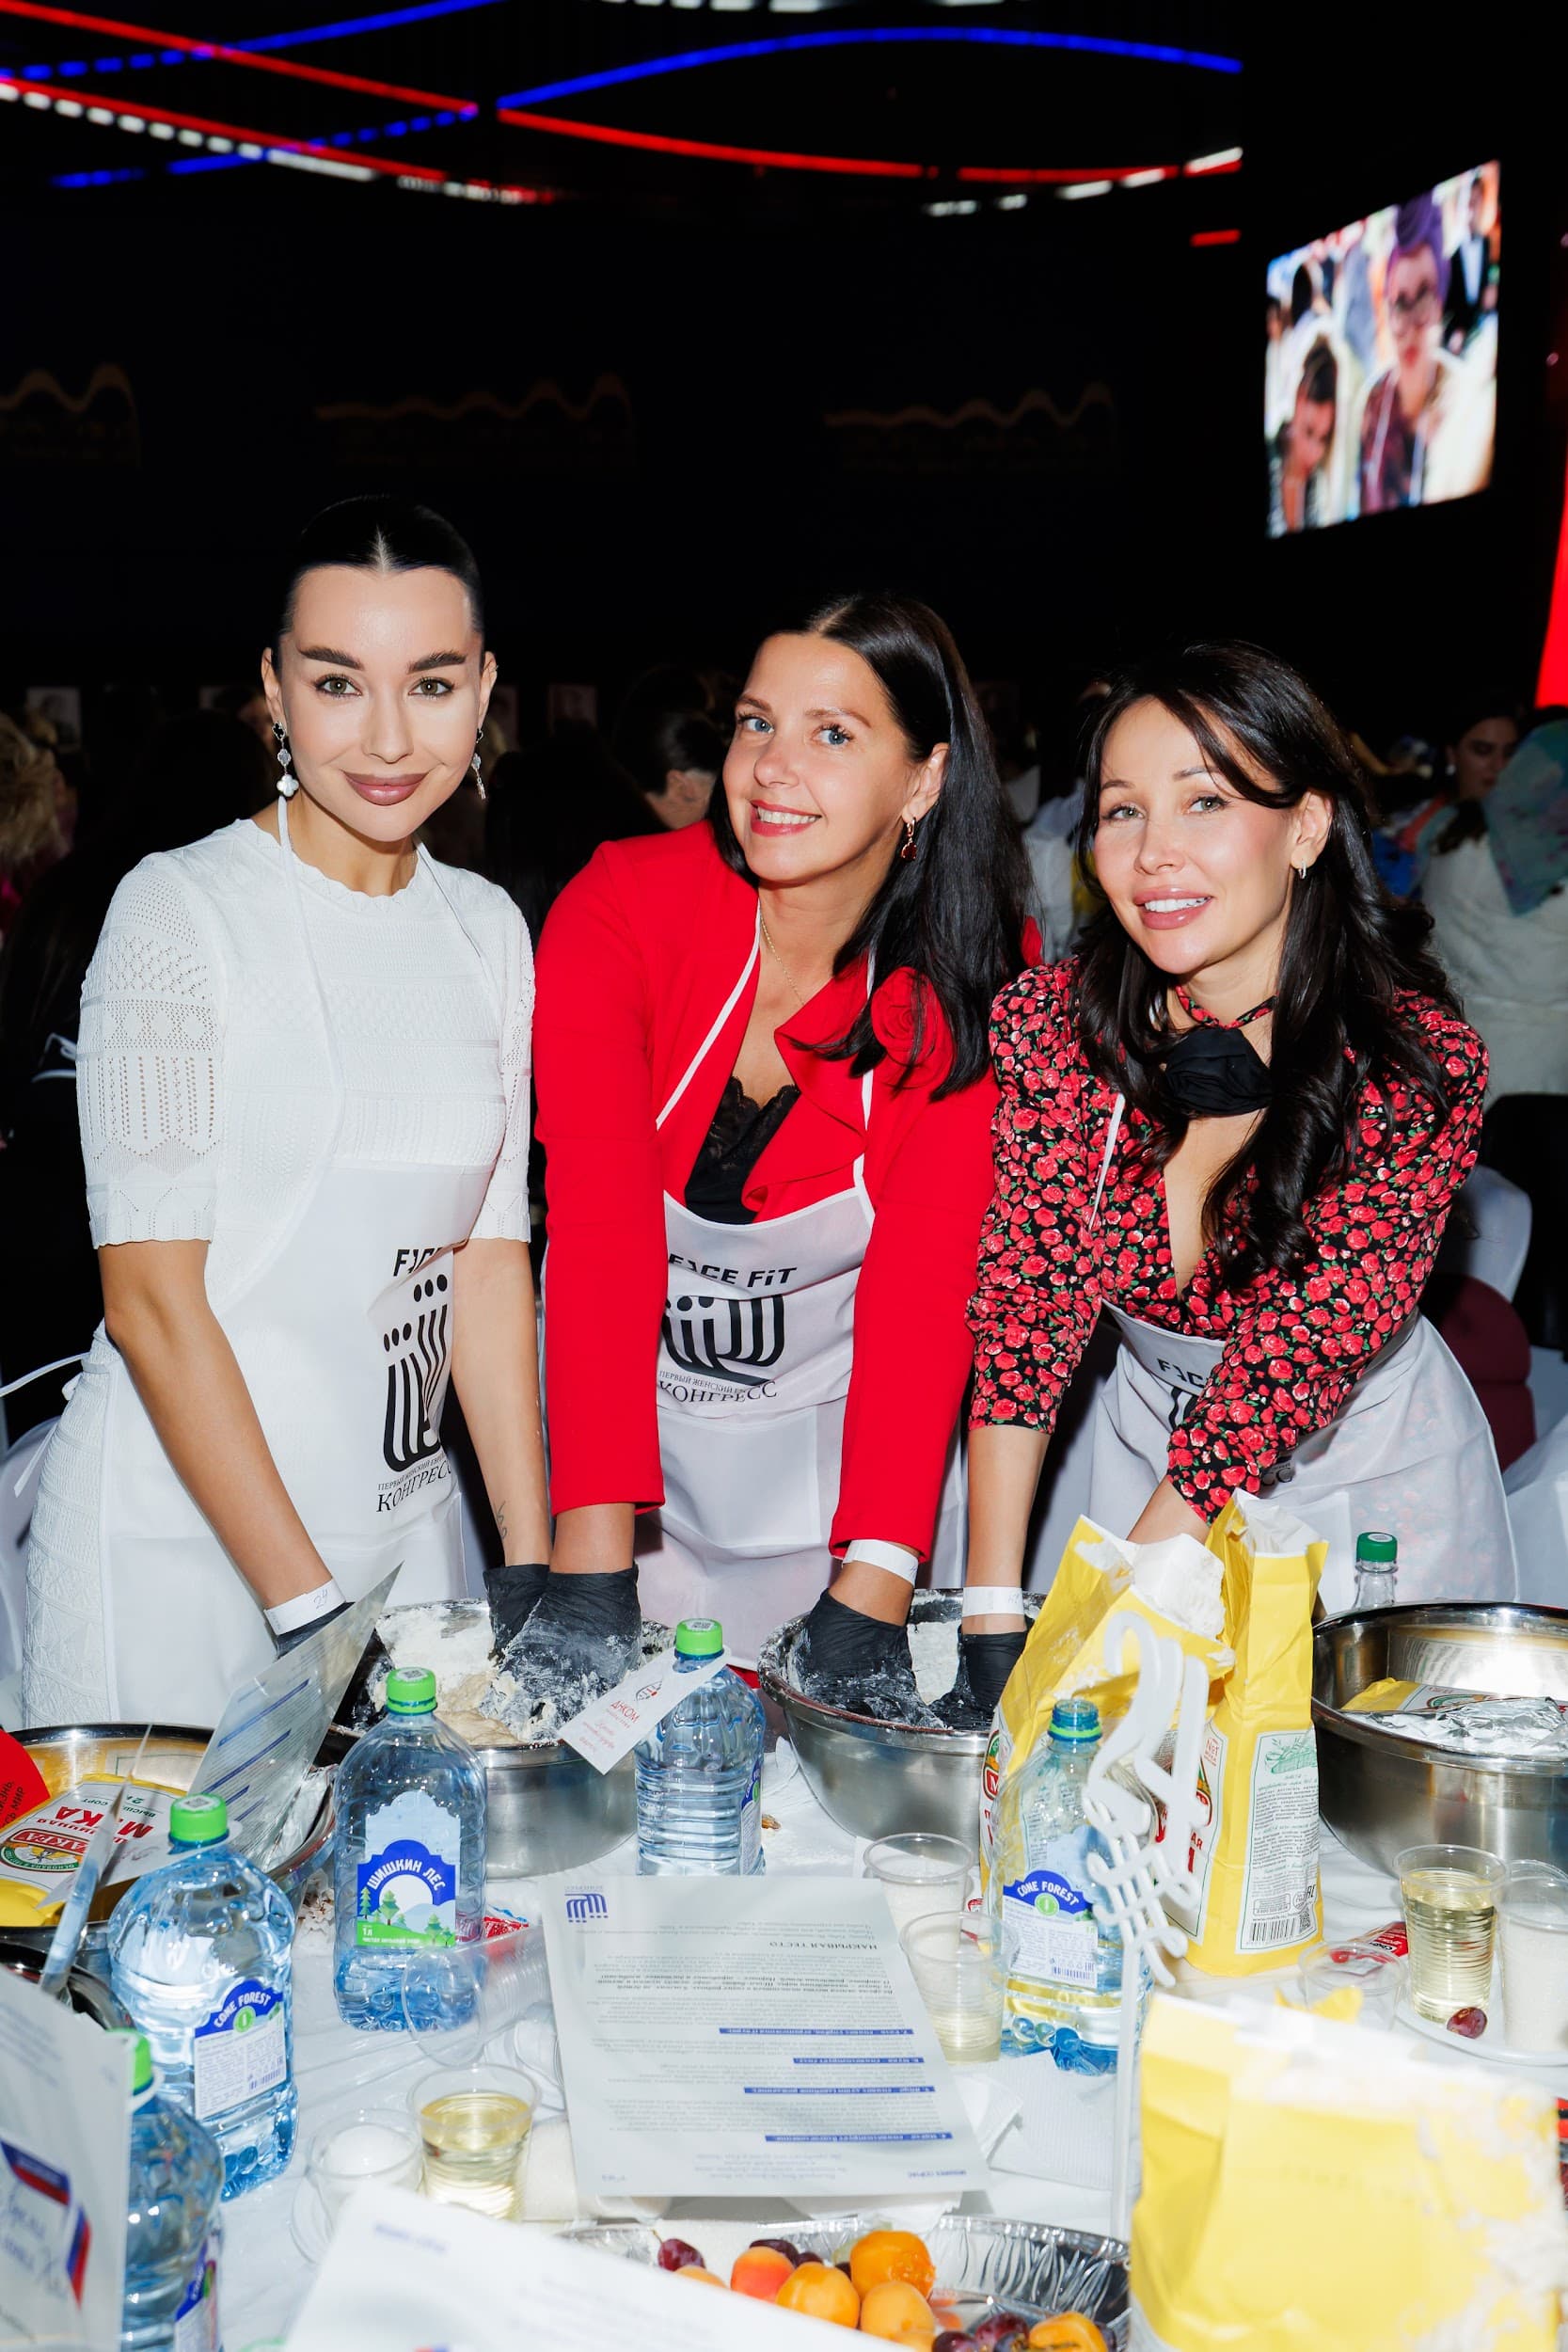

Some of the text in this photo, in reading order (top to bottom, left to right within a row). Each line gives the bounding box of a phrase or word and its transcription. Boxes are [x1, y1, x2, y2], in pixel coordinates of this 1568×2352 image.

[659, 1370, 692, 1385] ПЕРВЫЙ
[692, 1378, 733, 1393] ЖЕНСКИЙ
[55, 1806, 154, 1838] МКА
[367, 1858, 446, 1891] ШИШКИН ЛЕС
[1017, 1881, 1080, 1907] CONE FOREST
[810, 1942, 878, 1950] НАКРЫВАЯ
[214, 1992, 272, 2028] CONE FOREST
